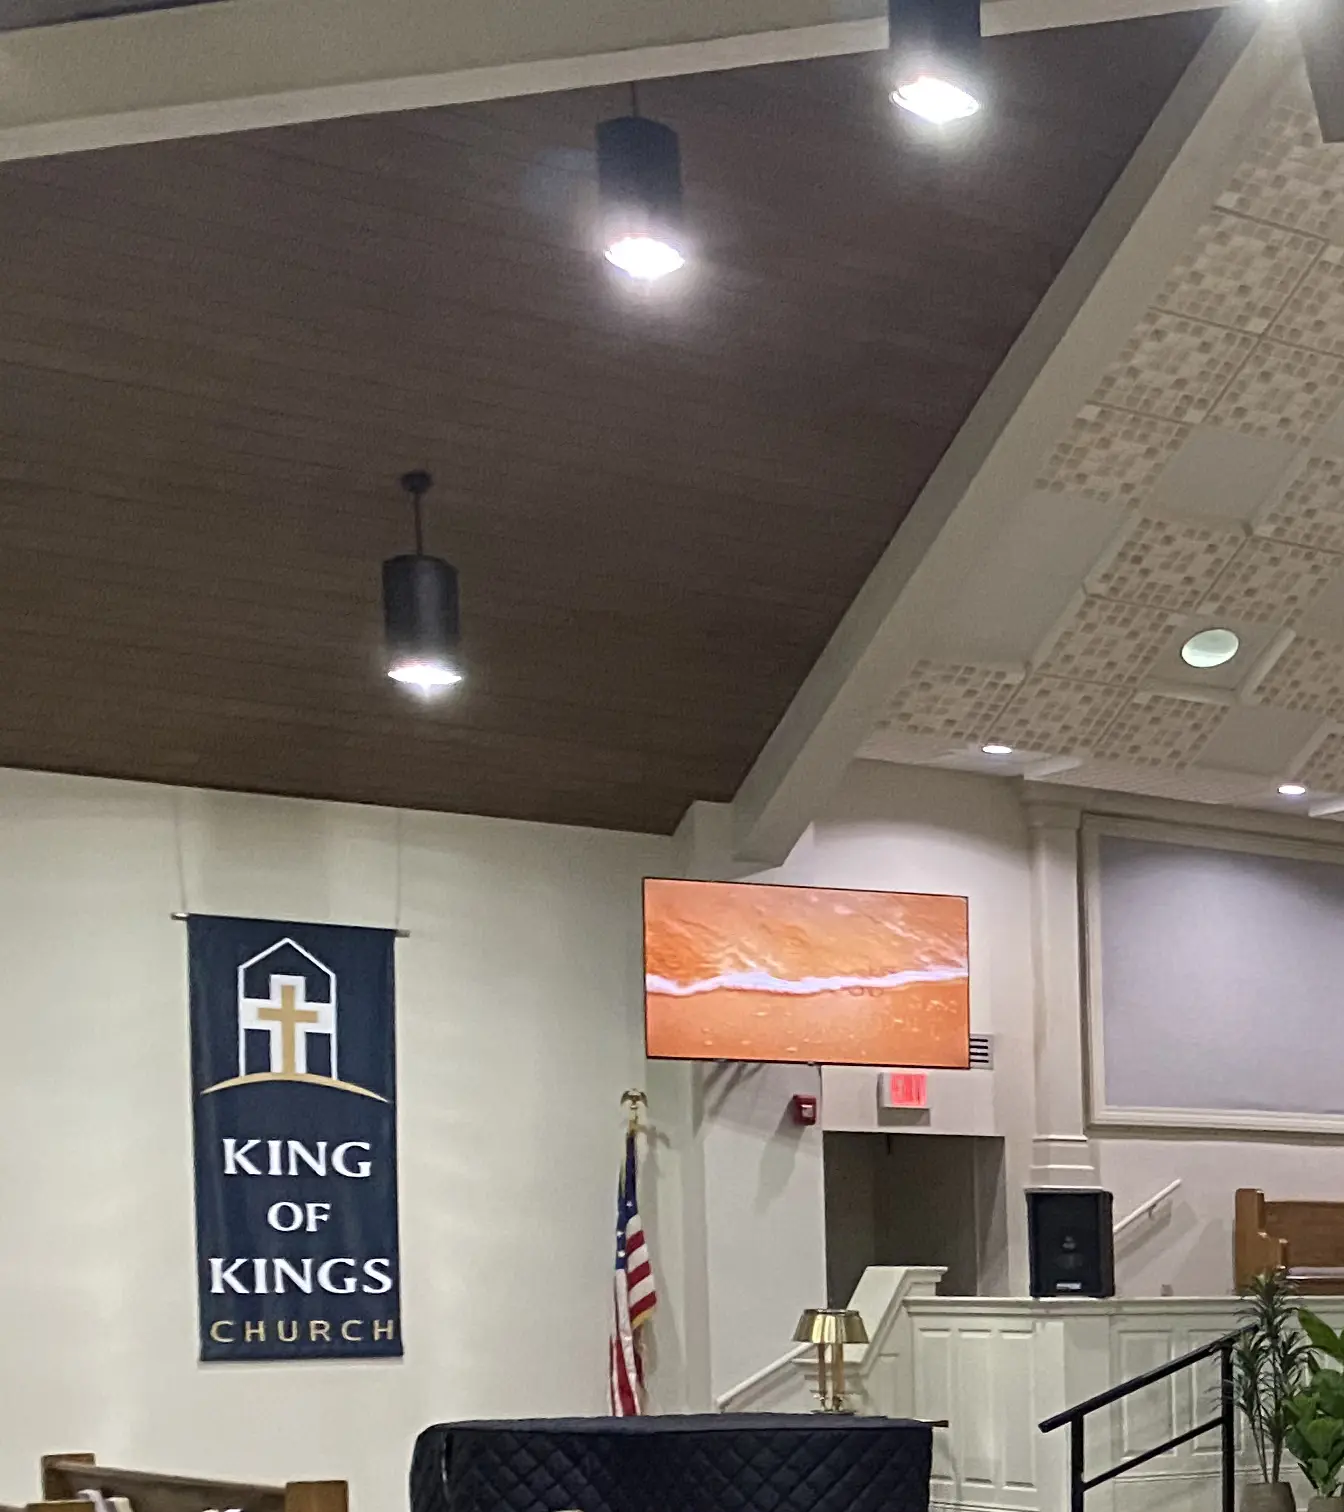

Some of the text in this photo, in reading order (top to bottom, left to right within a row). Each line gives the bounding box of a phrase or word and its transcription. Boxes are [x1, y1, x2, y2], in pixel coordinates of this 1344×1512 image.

[223, 1138, 372, 1178] KING
[266, 1201, 331, 1232] OF
[208, 1257, 393, 1295] KINGS
[209, 1319, 395, 1343] CHURCH
